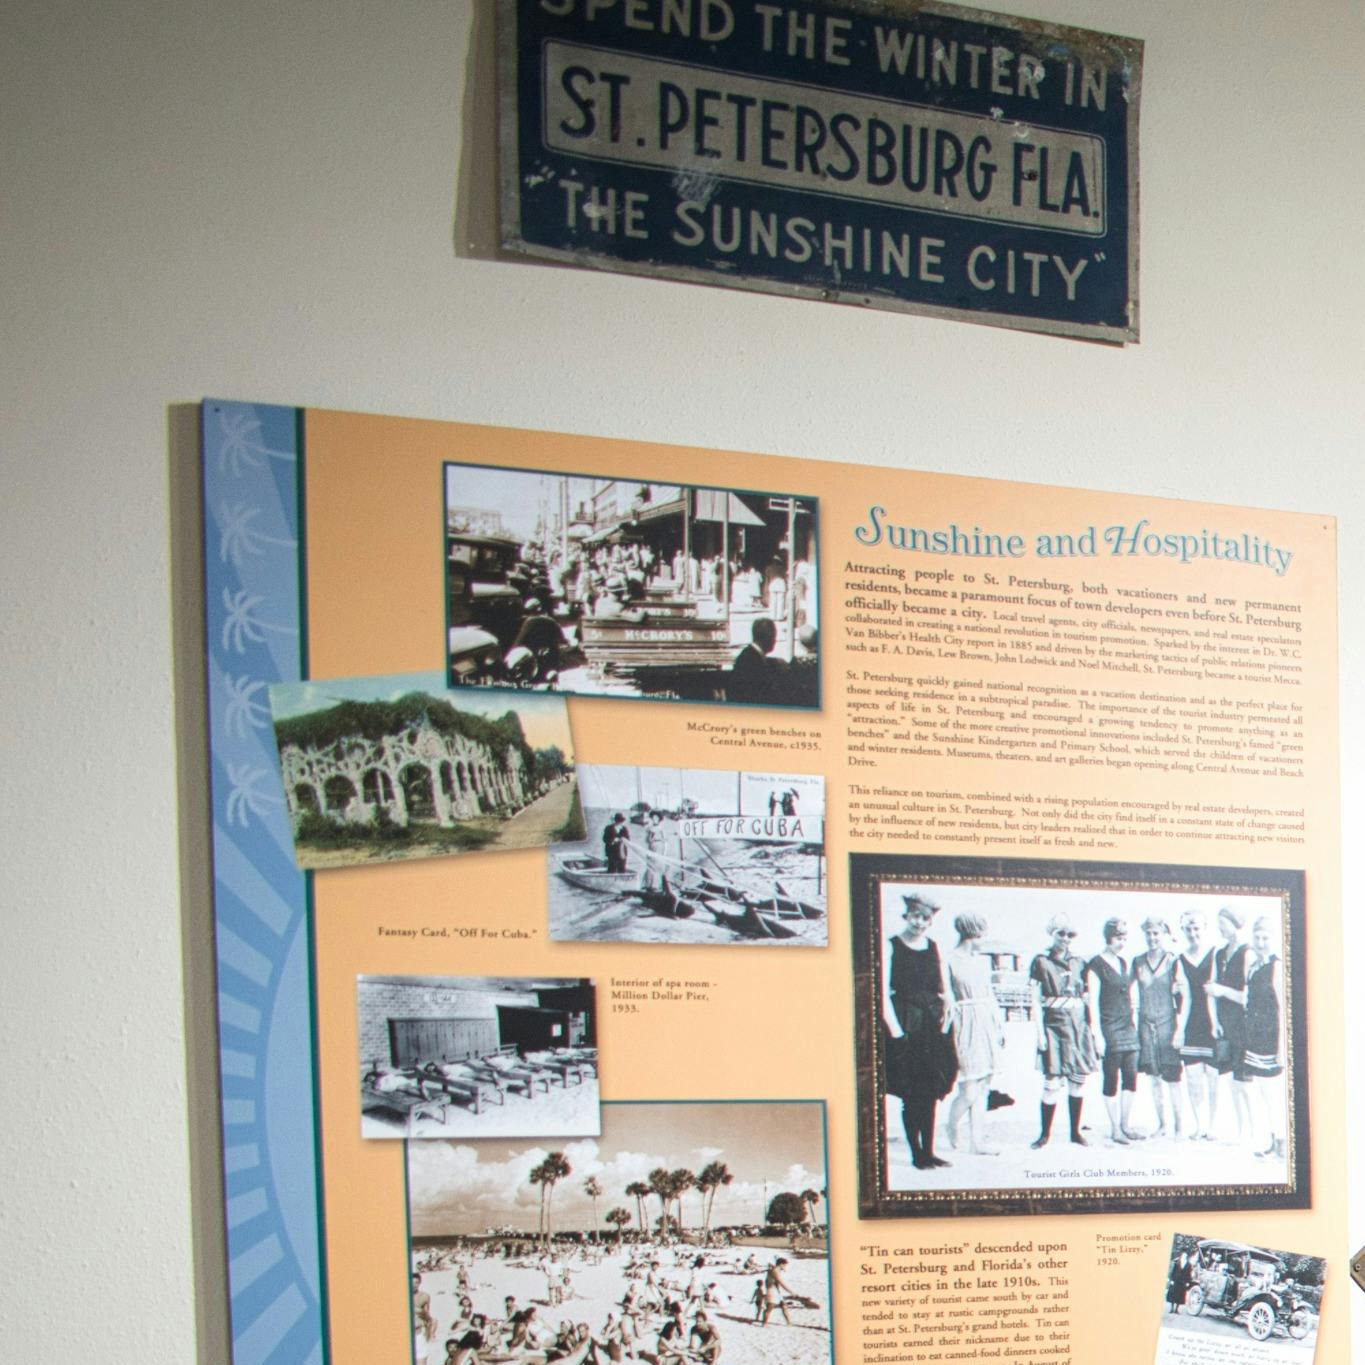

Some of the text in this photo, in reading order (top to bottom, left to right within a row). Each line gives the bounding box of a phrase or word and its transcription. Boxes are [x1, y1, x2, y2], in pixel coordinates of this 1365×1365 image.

[754, 3, 853, 66] THE
[874, 25, 1046, 99] WINTER
[1064, 57, 1108, 112] IN
[559, 65, 1100, 219] ST. PETERSBURG FLA.
[672, 199, 945, 283] SUNSHINE
[855, 505, 1294, 577] Sunshine and Hospitality
[845, 561, 1302, 614] Attracting people to St. Petersburg, both vacationers and new permanent
[683, 816, 804, 838] OFF FOR CUBA
[859, 1241, 1067, 1257] "Tin can tourists" descended upon
